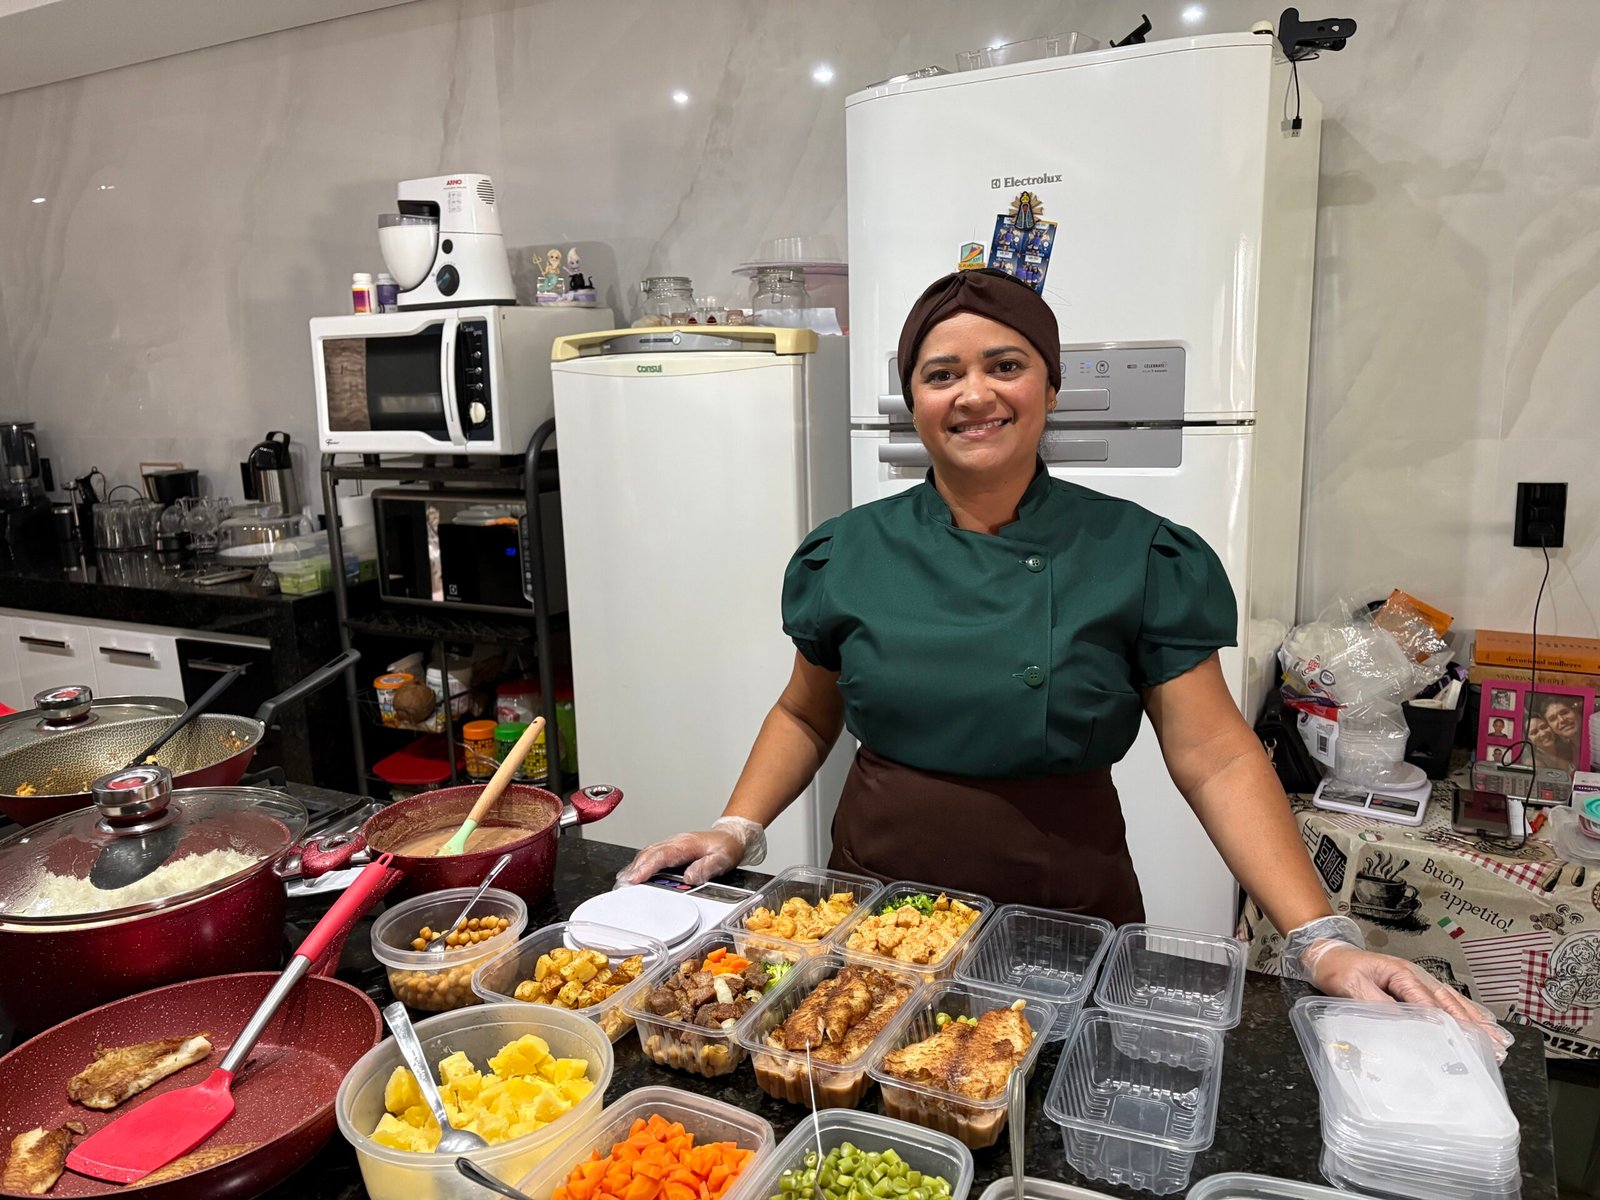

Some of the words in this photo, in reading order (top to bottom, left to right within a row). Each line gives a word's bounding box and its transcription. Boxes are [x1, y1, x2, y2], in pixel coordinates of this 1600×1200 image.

[1004, 173, 1062, 188] Electrolux
[1316, 838, 1332, 867] HOT
[1421, 857, 1465, 890] Buon
[1440, 890, 1514, 931] appetito!
[1543, 1020, 1583, 1035] original
